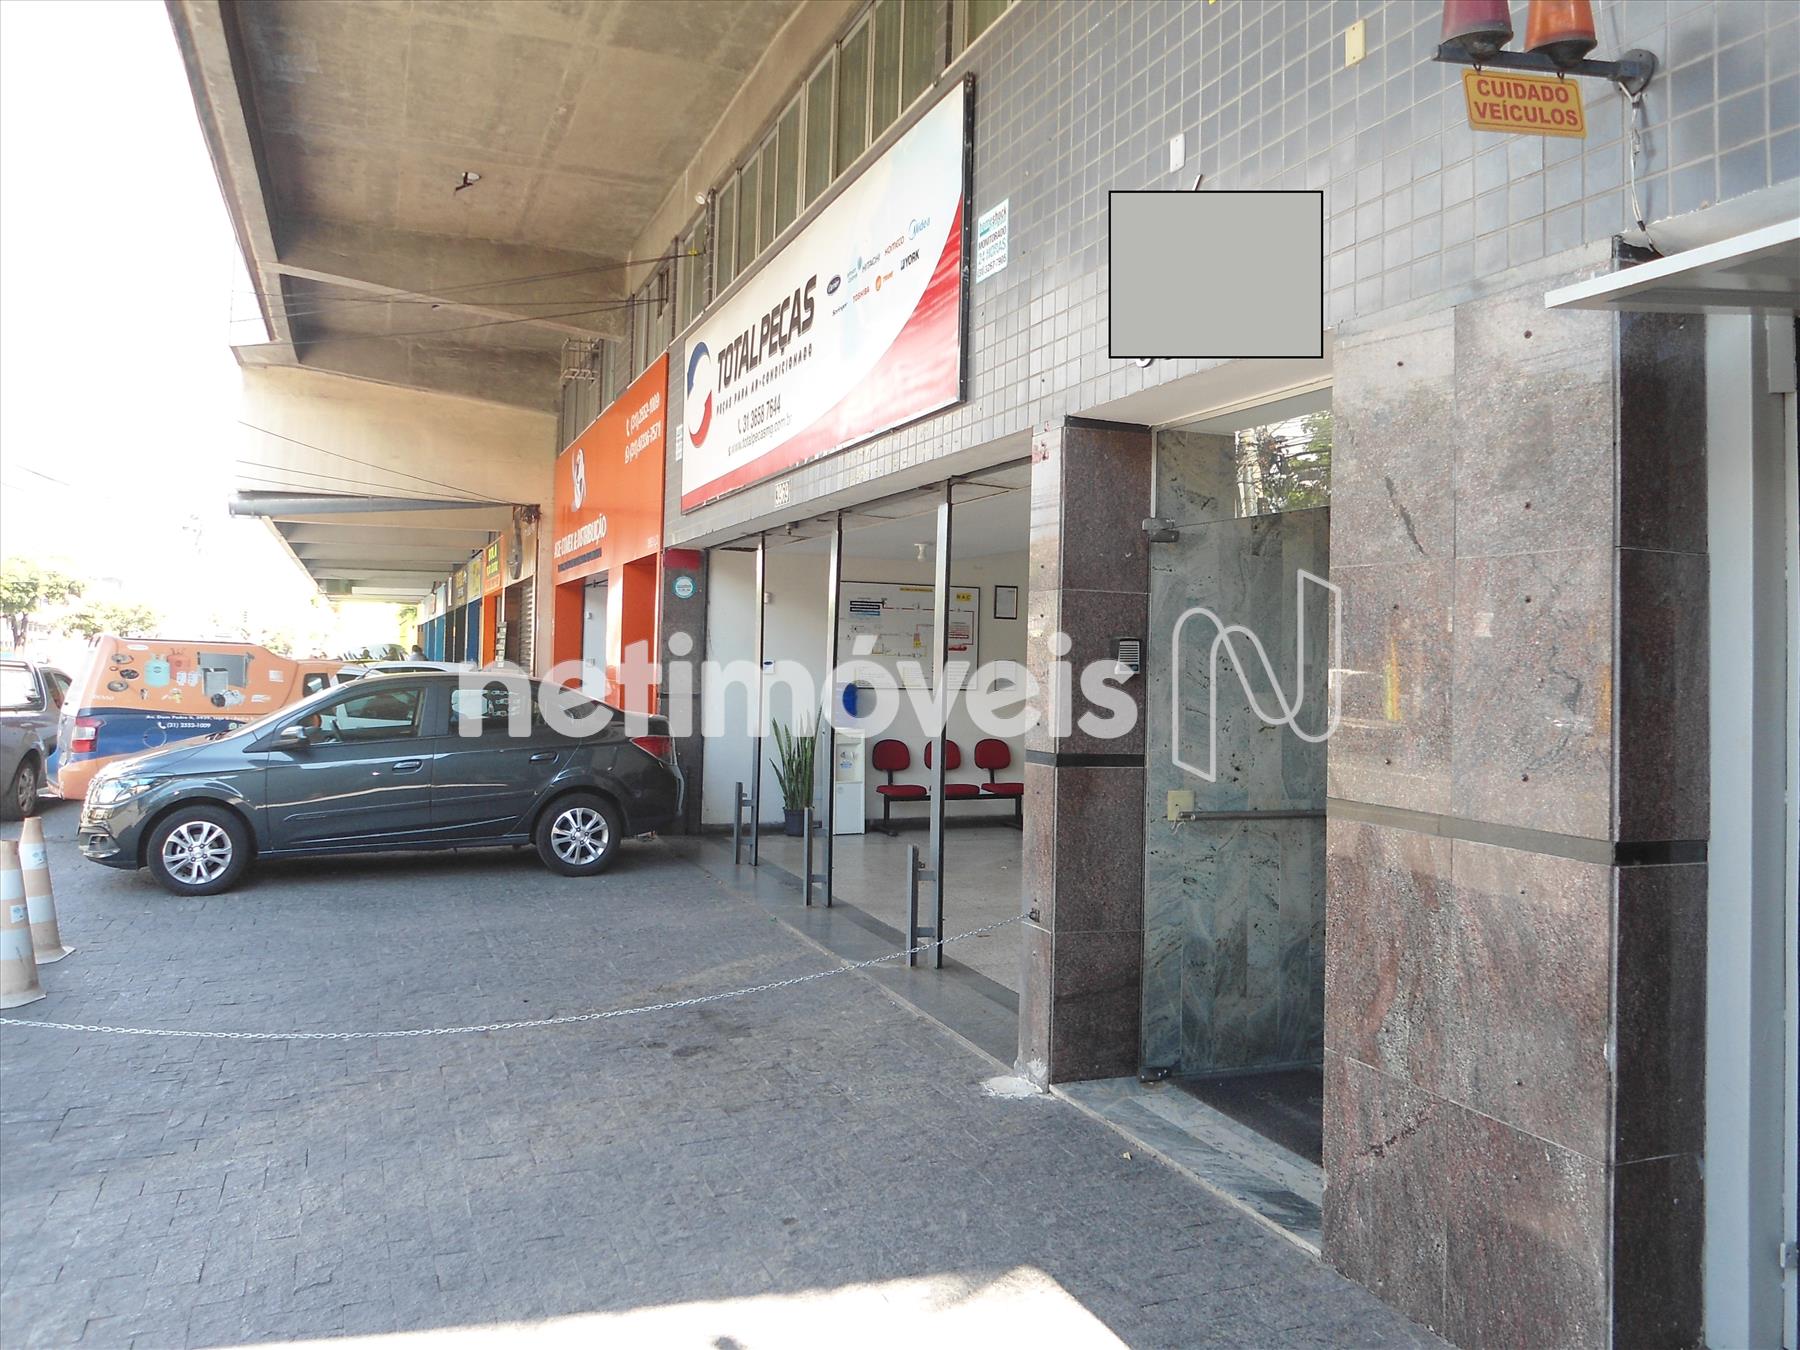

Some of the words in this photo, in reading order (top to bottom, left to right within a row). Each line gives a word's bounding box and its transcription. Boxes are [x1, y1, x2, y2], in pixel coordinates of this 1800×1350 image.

[1476, 79, 1570, 104] CUIDADO
[1473, 100, 1579, 126] VEÍCULOS
[979, 225, 1007, 249] MONITORADO
[985, 237, 1007, 258] HORAS
[862, 252, 881, 272] HITACHI
[905, 248, 920, 267] YORK
[716, 396, 732, 416] PEÇAS
[734, 385, 748, 405] PARA
[751, 342, 813, 394] AR-CONDICIONADO
[742, 412, 750, 433] 31
[766, 392, 781, 420] 7644
